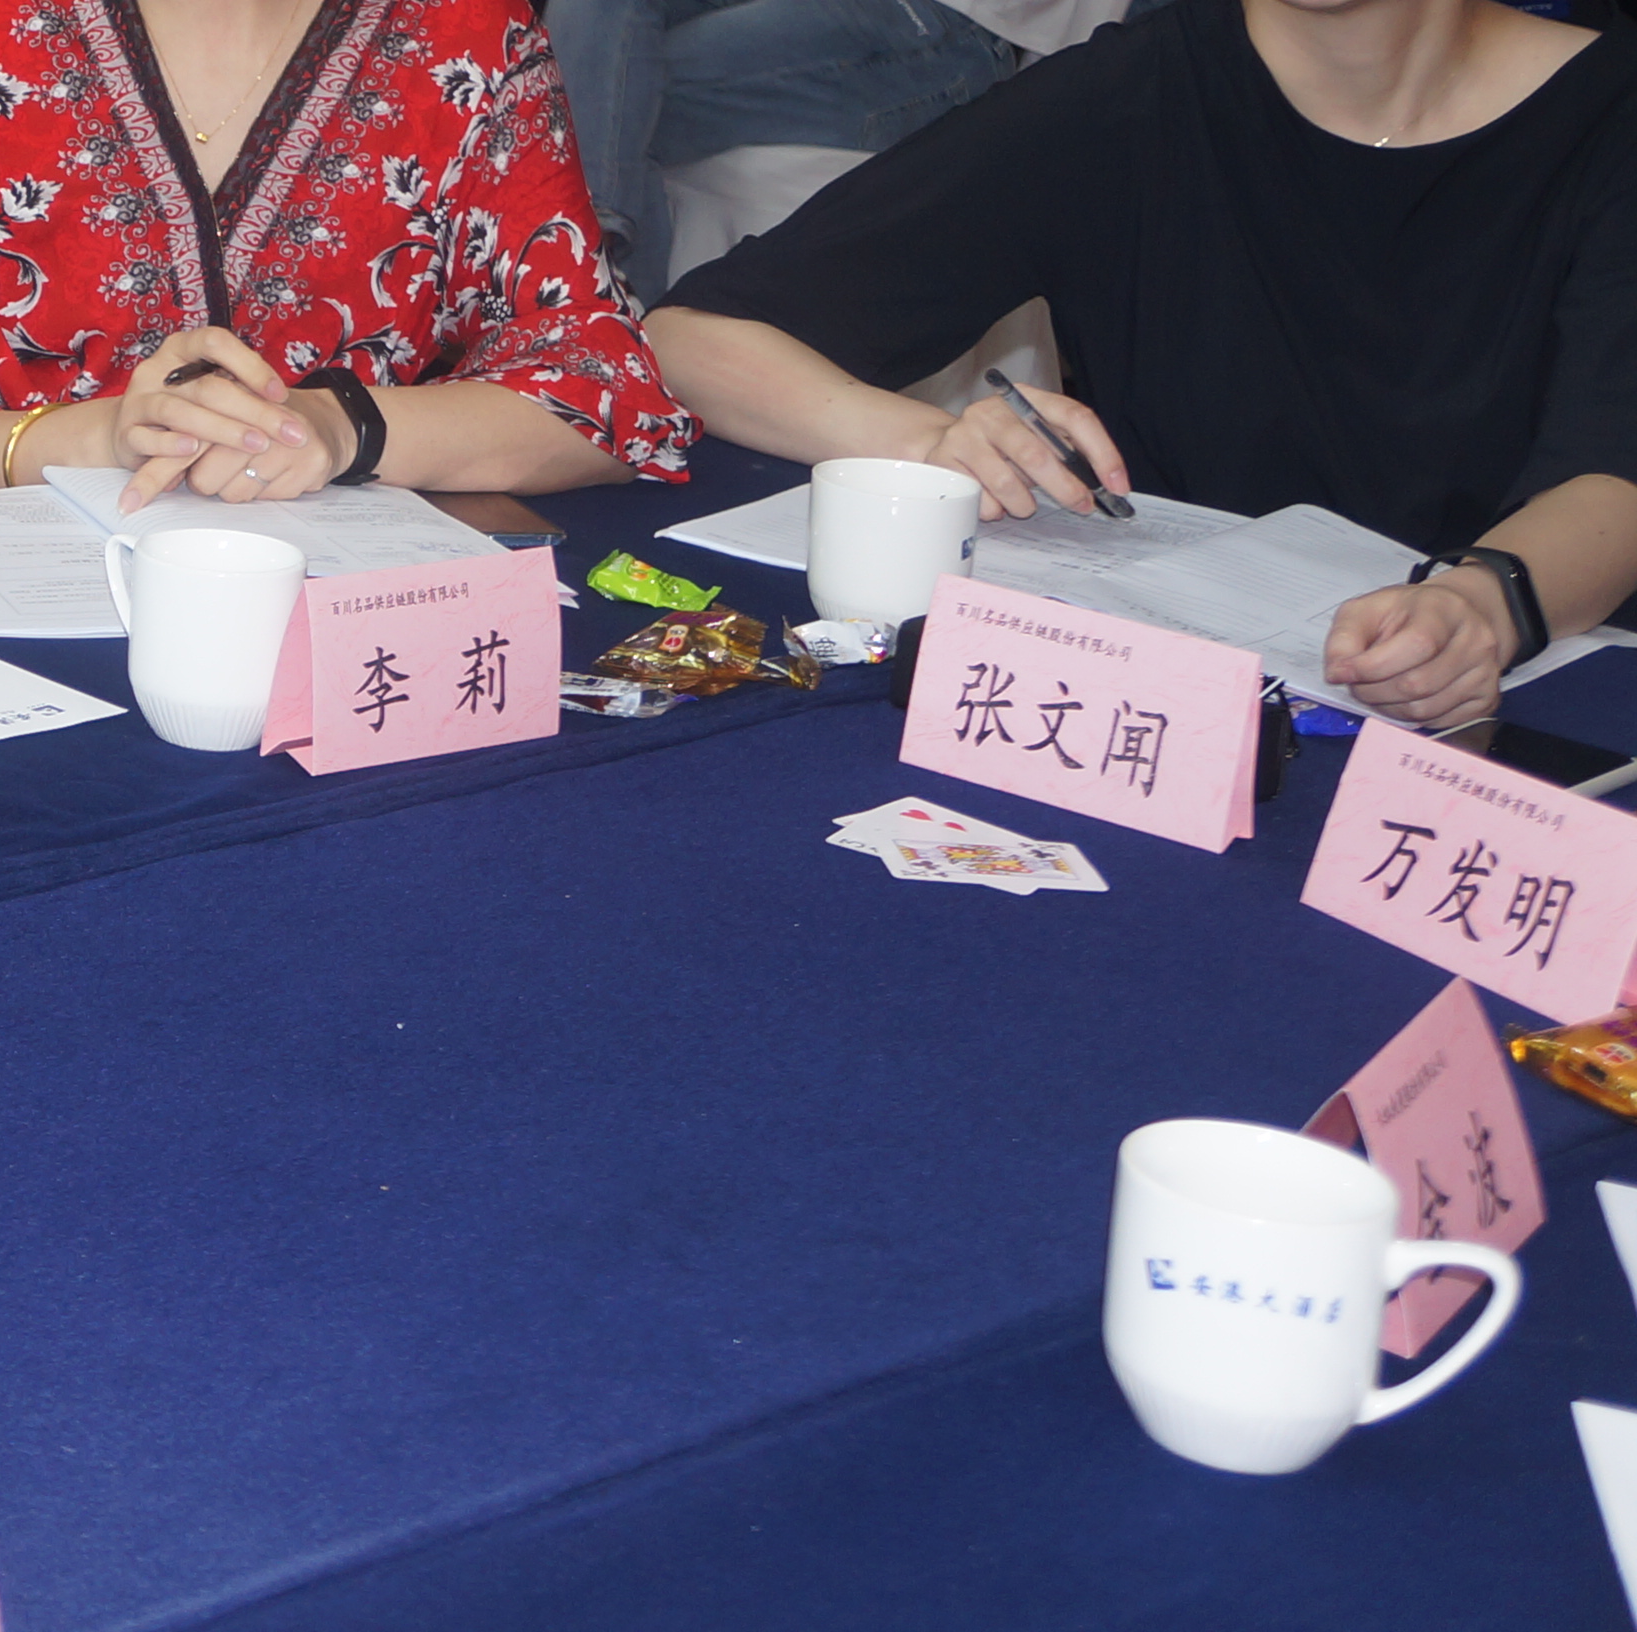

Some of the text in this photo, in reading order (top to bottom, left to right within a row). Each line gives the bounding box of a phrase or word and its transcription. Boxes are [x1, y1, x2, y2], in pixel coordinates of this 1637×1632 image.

[330, 582, 469, 616] 百川名品供应链股份有限公司
[955, 602, 1133, 662] 百川名品供应链股份有限公司
[352, 630, 511, 734] 李莉
[953, 662, 1169, 798] 张文闻
[1398, 752, 1568, 832] 百川名品供应链股份有限公司
[1358, 818, 1576, 972] 万发明
